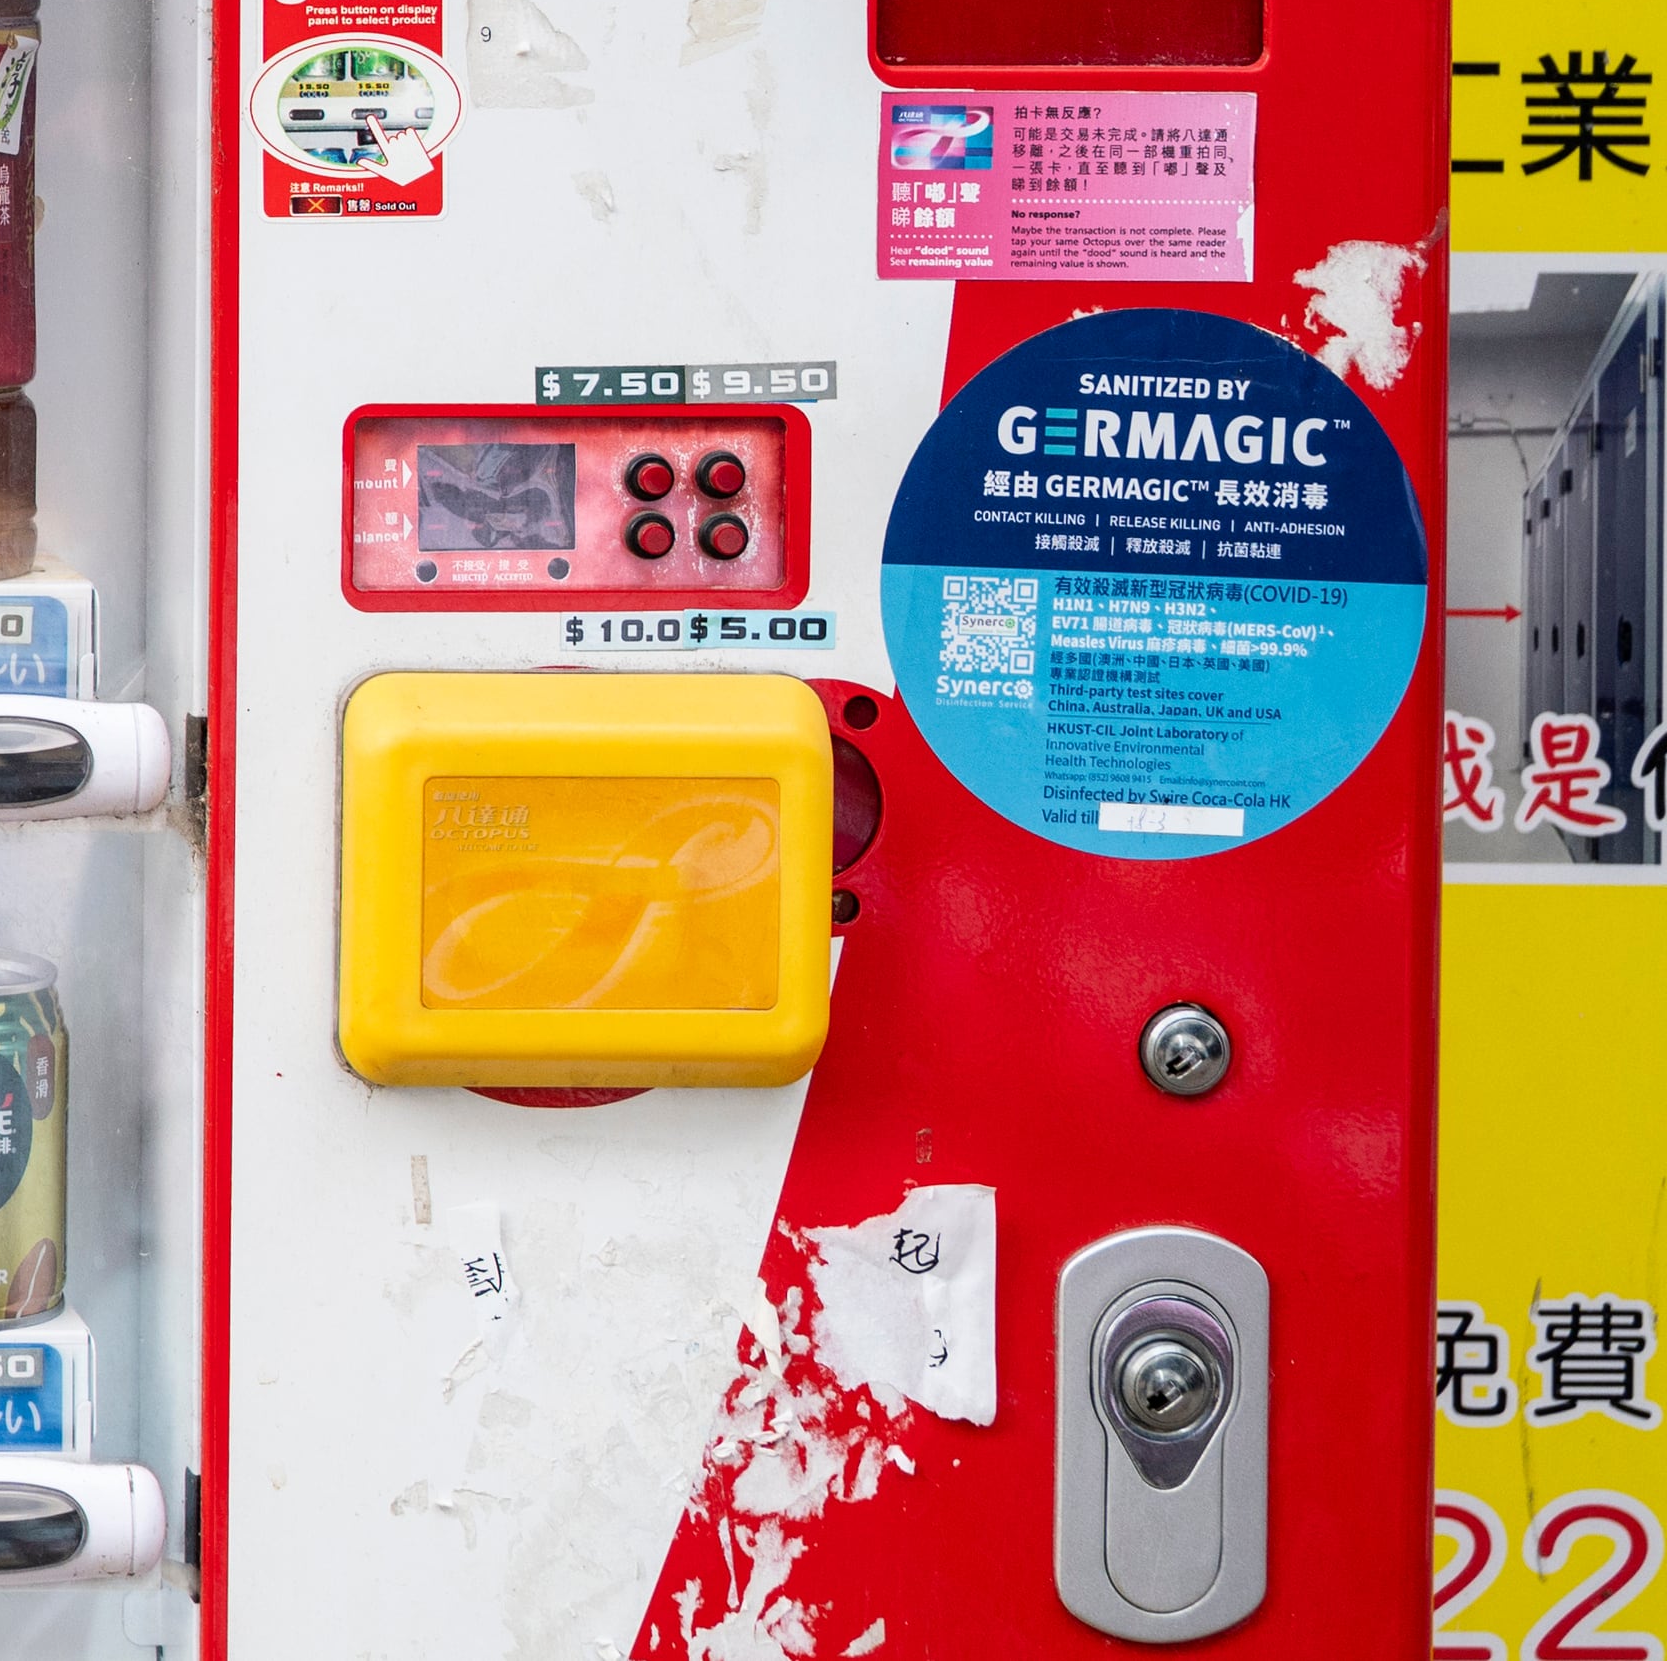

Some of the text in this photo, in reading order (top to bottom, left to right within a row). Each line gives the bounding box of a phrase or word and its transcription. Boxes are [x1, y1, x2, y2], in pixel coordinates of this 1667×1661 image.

[306, 5, 437, 18] Press button on display
[307, 15, 436, 27] panel to select product
[1015, 106, 1101, 119] 拍卡無反應?
[290, 182, 363, 193] 注意 Remarks!!
[347, 199, 416, 212] 售罄 Sold Out
[1012, 210, 1080, 220] No response?
[890, 246, 912, 255] Hear
[957, 246, 988, 255] sound
[890, 257, 993, 268] See remaining value
[1079, 374, 1250, 401] SANITIZED BY
[983, 470, 1038, 498] 經由
[1215, 480, 1328, 510] 長效消毒
[974, 510, 1345, 536] CONTACT KILLING RELEASE KILLING ANTI-ADHESION
[1035, 534, 1099, 552] 接觸殺滅
[1126, 537, 1191, 556] 釋放殺滅
